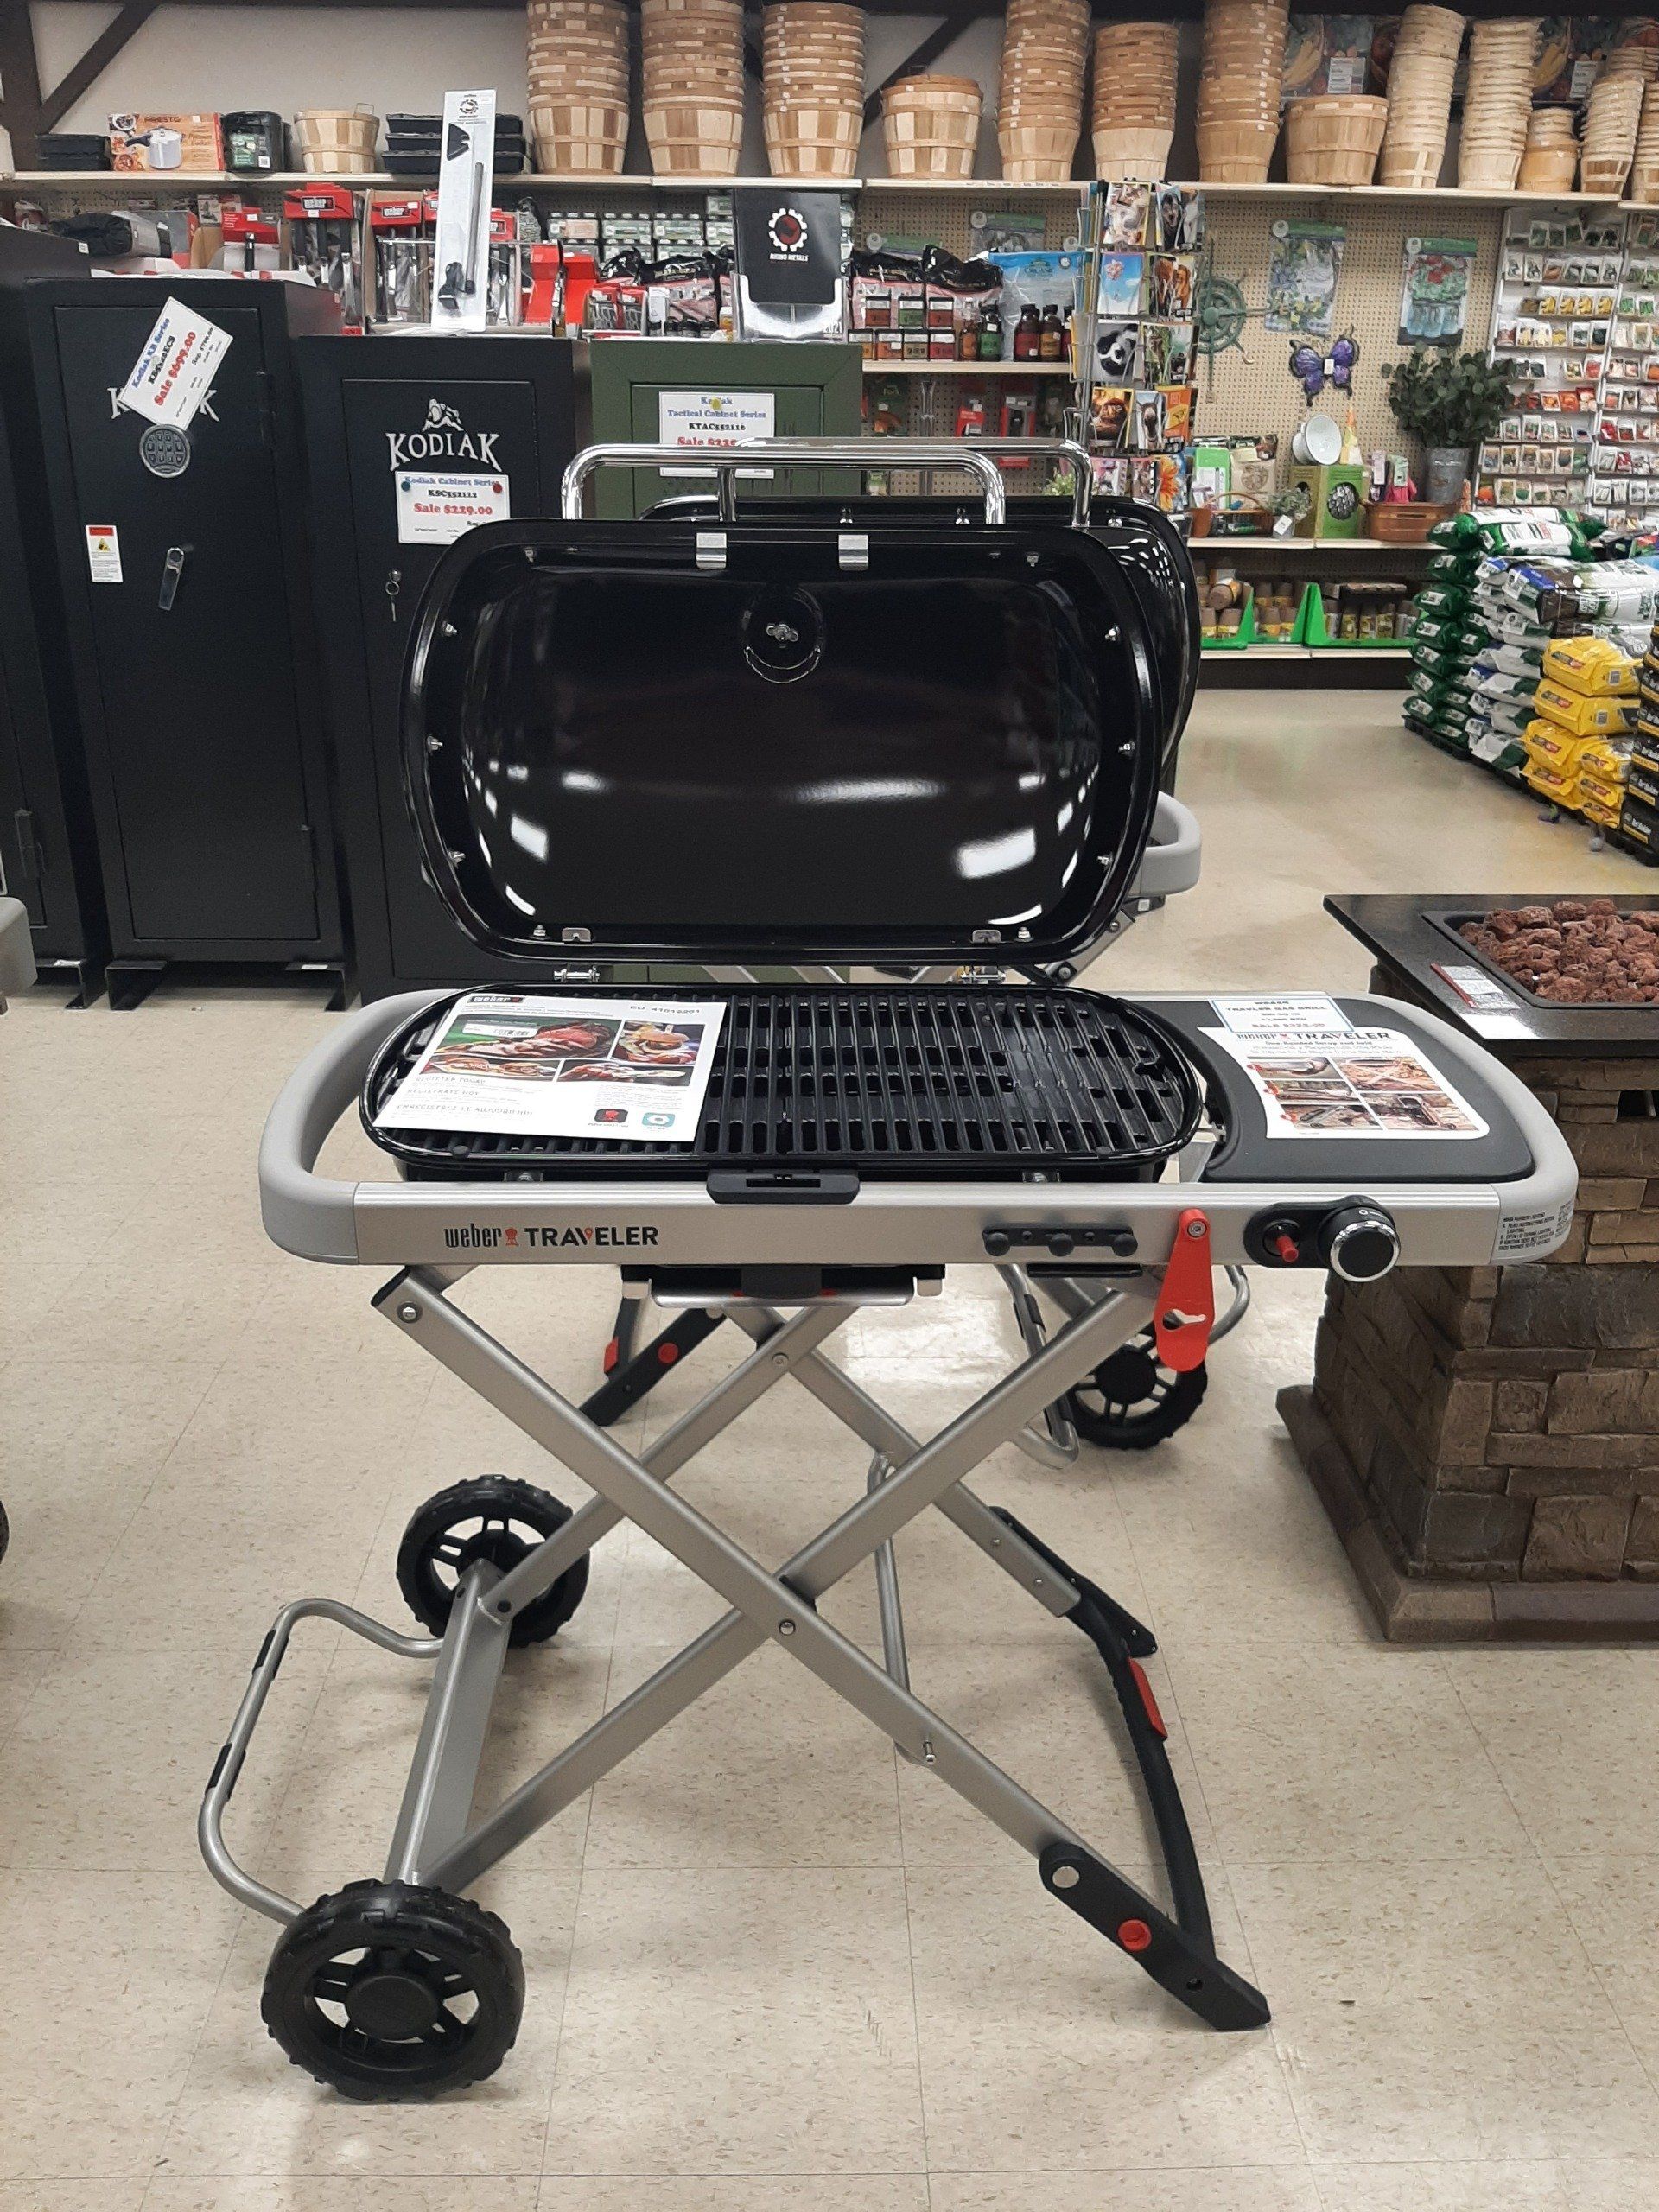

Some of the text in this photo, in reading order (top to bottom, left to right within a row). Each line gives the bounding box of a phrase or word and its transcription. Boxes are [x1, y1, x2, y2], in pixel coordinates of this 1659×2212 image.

[154, 379, 173, 406] Sale
[168, 331, 197, 379] $699.00
[701, 397, 733, 405] Koak
[667, 410, 702, 418] Tactical
[740, 410, 766, 419] Series
[677, 436, 704, 447] Sale
[385, 433, 503, 473] KODIAK
[438, 477, 472, 486] Cabinet
[414, 503, 441, 513] Sale
[444, 1223, 659, 1248] weber TRAVELER
